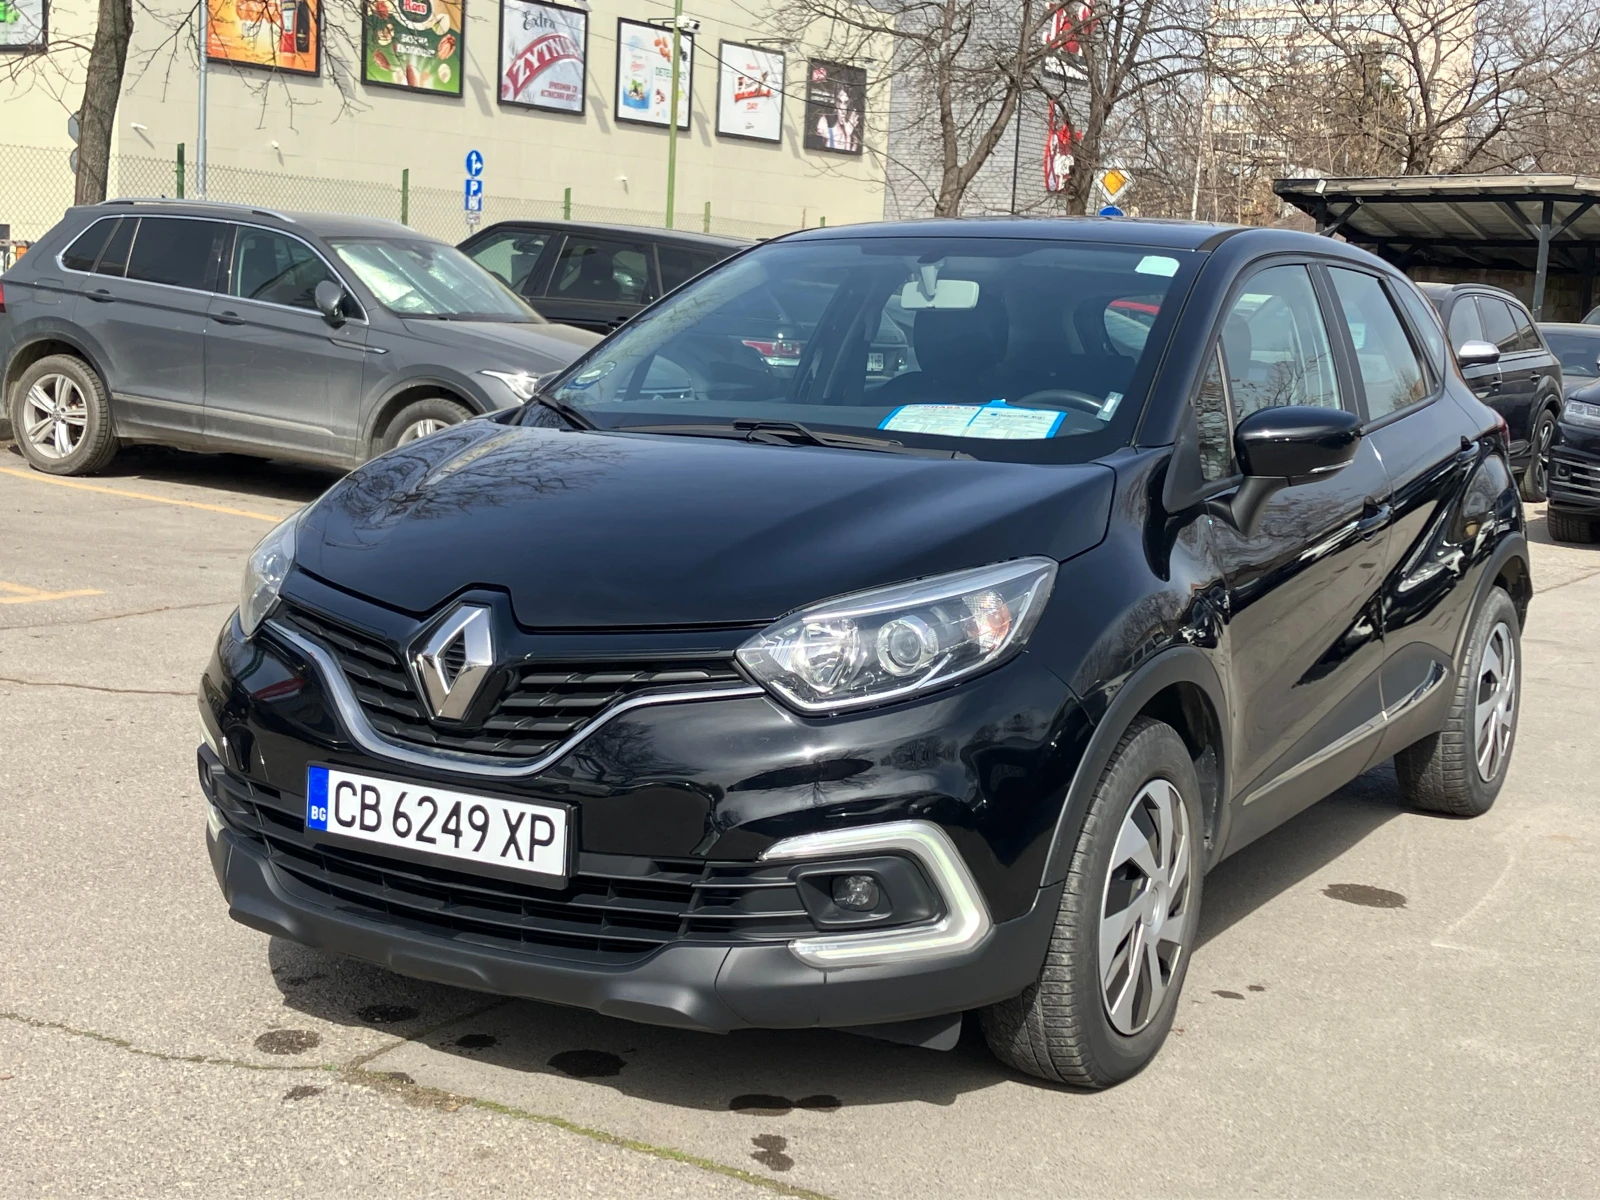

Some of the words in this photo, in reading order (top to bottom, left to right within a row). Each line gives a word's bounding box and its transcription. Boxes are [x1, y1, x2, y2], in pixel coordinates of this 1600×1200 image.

[523, 10, 556, 30] Extra
[470, 181, 479, 196] P
[311, 805, 327, 822] BG
[334, 780, 383, 833] CB
[392, 791, 490, 852] 6249
[500, 808, 556, 862] XP
